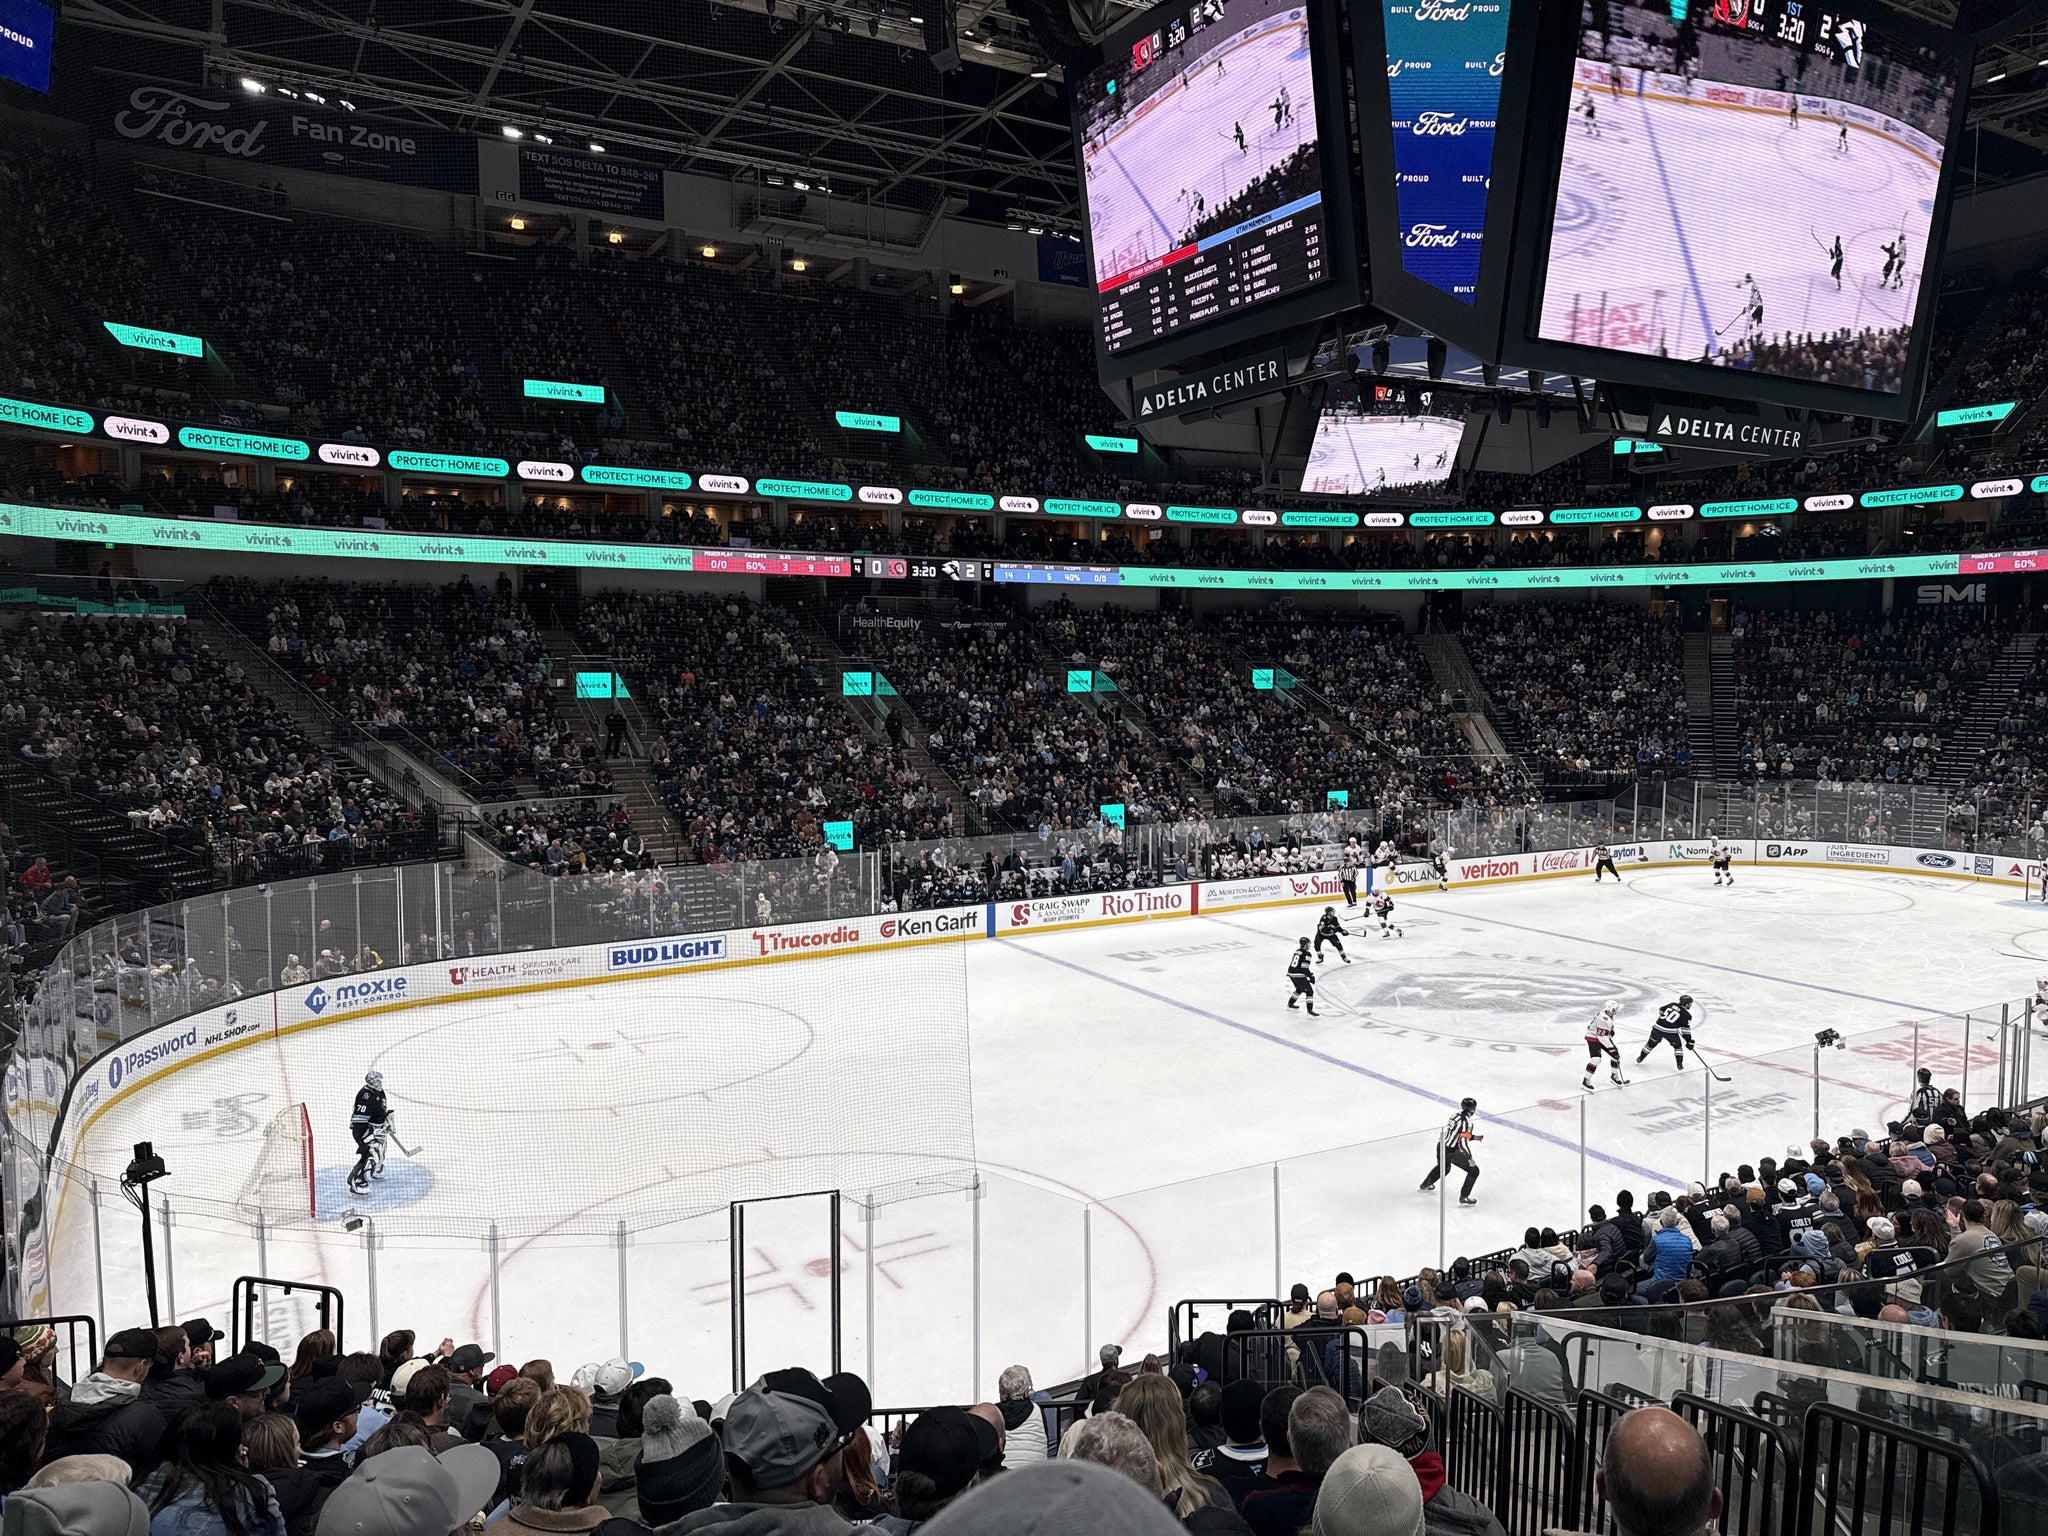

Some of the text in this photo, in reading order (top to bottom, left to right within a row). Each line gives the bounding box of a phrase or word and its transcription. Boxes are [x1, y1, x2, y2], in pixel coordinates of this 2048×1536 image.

[1415, 0, 1470, 21] Ford
[1787, 1, 1803, 17] 1ST
[1193, 9, 1200, 23] 2
[1748, 19, 1760, 31] SOG
[1777, 14, 1805, 44] 3:20
[1820, 14, 1832, 39] 2
[1152, 33, 1160, 48] 0
[1168, 26, 1185, 48] 3:20
[1815, 43, 1826, 53] SOG
[115, 87, 268, 157] Ford
[1413, 111, 1468, 135] Ford
[292, 116, 416, 155] Fan Zone
[525, 151, 551, 164] TEXT
[551, 156, 573, 167] SOS
[574, 158, 604, 173] DELTA
[605, 164, 619, 175] TO
[1406, 223, 1459, 247] Ford
[132, 332, 166, 347] vivint
[1155, 360, 1278, 410] DELTA CENTER
[547, 386, 573, 397] vivint
[22, 405, 59, 424] HOME
[62, 413, 83, 427] ICE
[1958, 410, 1985, 421] vivint
[855, 417, 876, 427] vivint
[117, 422, 148, 437] vivint
[1677, 417, 1801, 448] DELTA CENTER
[188, 432, 300, 455] PROTECT HOME ICE
[1101, 440, 1119, 449] vivint
[330, 449, 361, 461] vivint
[397, 455, 500, 472] PROTECT HOME ICE
[527, 465, 555, 477] vivint
[762, 483, 845, 497] PROTECT HOME ICE
[1980, 483, 2006, 494] vivint
[867, 490, 889, 500] vivint
[914, 493, 988, 506] PROTECT HOME ICE
[1867, 488, 1956, 504] PROTECT HOME ICE
[1007, 500, 1027, 509] vivint
[1813, 498, 1837, 507] vivint
[1171, 510, 1232, 520] PROTECT HOME ICE
[1248, 514, 1267, 522] vivint
[1508, 514, 1530, 522] vivint
[1556, 509, 1635, 520] PROTECT HOME ICE
[1656, 508, 1679, 517] vivint
[1287, 515, 1353, 523] PROTECT HOME ICE
[1371, 516, 1391, 524] vivint
[56, 519, 97, 534] vivint
[153, 527, 189, 541] vivint
[334, 539, 368, 551] vivint
[504, 547, 537, 559] vivint
[662, 554, 692, 565] vivint
[711, 560, 727, 569] 0/0
[1929, 560, 1958, 570] vivint
[2014, 560, 2036, 569] 60%
[746, 561, 766, 571] 60%
[783, 563, 788, 572] 3
[809, 564, 814, 573] 9
[830, 565, 840, 573] 10
[855, 564, 861, 573] 4
[872, 560, 881, 574] 0
[912, 566, 937, 577] 3:20
[966, 564, 974, 577] 2
[1858, 563, 1886, 574] vivint
[1977, 562, 1994, 570] 0/0
[985, 570, 990, 578] 6
[1005, 572, 1013, 580] 14
[1064, 574, 1080, 582] 40%
[1094, 574, 1107, 583] 0/0
[1149, 574, 1170, 582] vivint
[1248, 576, 1268, 584] vivint
[1528, 575, 1553, 584] vivint
[1590, 574, 1617, 583] vivint
[1720, 569, 1747, 580] vivint
[1352, 576, 1376, 585] vivint
[1408, 576, 1432, 585] vivint
[853, 616, 921, 630] HealthEquity
[1686, 847, 1709, 855] Nomi
[1830, 850, 1886, 860] INGREDIENTS
[1541, 851, 1580, 871] Coca-Cola
[1923, 854, 1949, 866] Ford
[1461, 859, 1519, 879] verizon
[1219, 887, 1248, 897] MORETON
[1253, 884, 1281, 894] COMPANY
[1032, 898, 1090, 911] CRAIG SWAPP
[1043, 906, 1085, 917] ASSOCIATES
[898, 911, 977, 936] Ken Garff
[769, 926, 859, 950] Trucordia
[612, 939, 722, 966] BUD LIGHT
[522, 957, 581, 970] OFFICIAL CARE
[472, 965, 516, 978] HEALTH
[522, 966, 563, 977] PROVIDER
[337, 976, 407, 1001] moxie
[337, 990, 407, 1009] PEST CONTROL
[1660, 1007, 1680, 1024] 50
[124, 1027, 197, 1075] 1Password
[356, 1104, 366, 1113] 70
[1790, 1217, 1812, 1228] COOLEY
